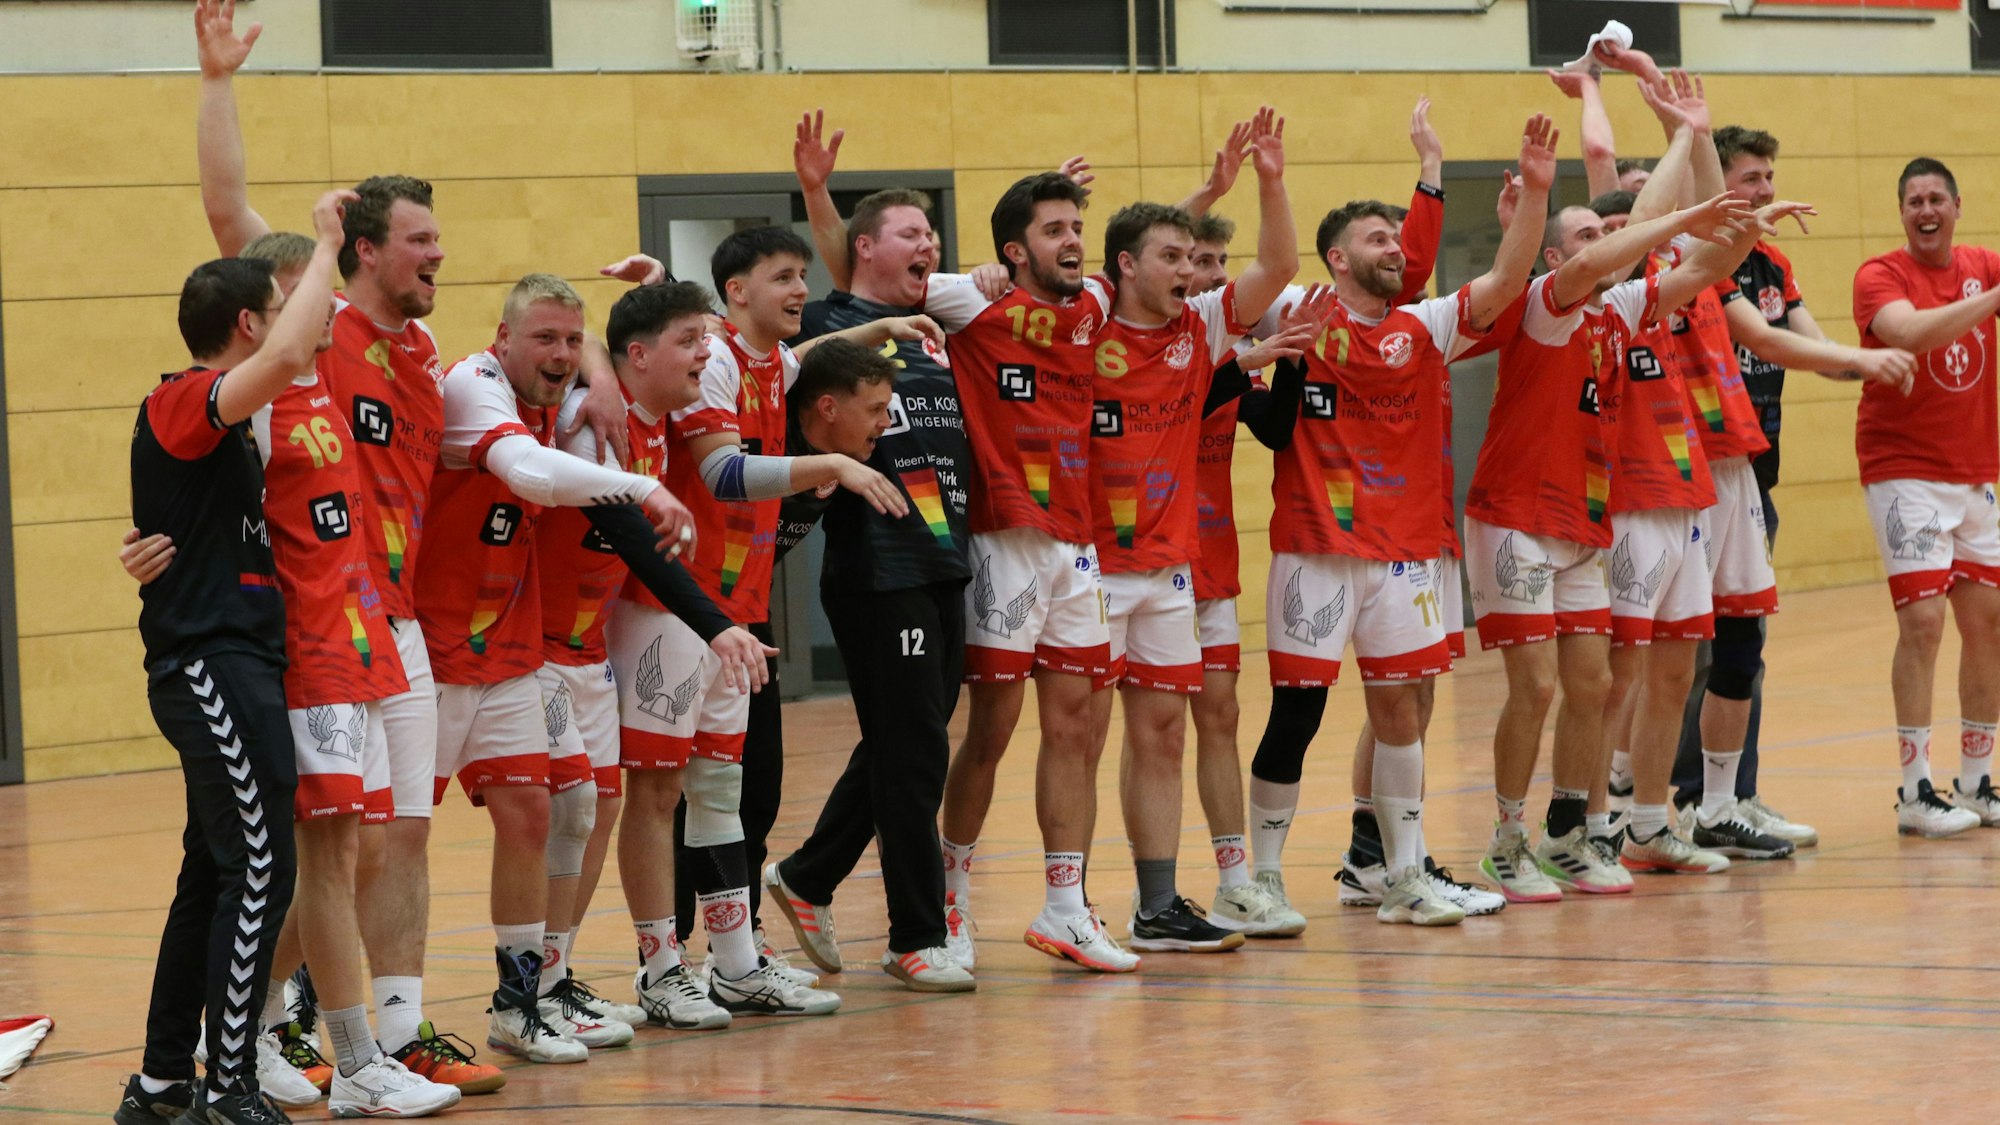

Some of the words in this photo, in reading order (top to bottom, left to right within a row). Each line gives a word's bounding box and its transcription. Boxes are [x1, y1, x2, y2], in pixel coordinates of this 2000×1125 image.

[1005, 305, 1056, 348] 18
[1095, 339, 1128, 378] 6
[905, 397, 932, 411] DR.
[934, 397, 958, 412] KOS
[1369, 392, 1417, 409] KOSKY
[1015, 424, 1044, 434] Ideen
[288, 416, 343, 469] 16
[895, 456, 925, 468] Ideen
[1413, 590, 1441, 628] 11
[900, 628, 925, 656] 12
[1062, 663, 1085, 672] Kempa
[1154, 681, 1176, 690] Kempa
[712, 750, 733, 760] Kempa
[656, 759, 678, 768] Kempa
[506, 774, 531, 783] Kempa
[558, 778, 582, 790] Kempa
[311, 806, 338, 816] Kempa
[365, 812, 387, 820] Kempa
[1045, 853, 1082, 861] Kempa
[699, 889, 743, 902] Kempa
